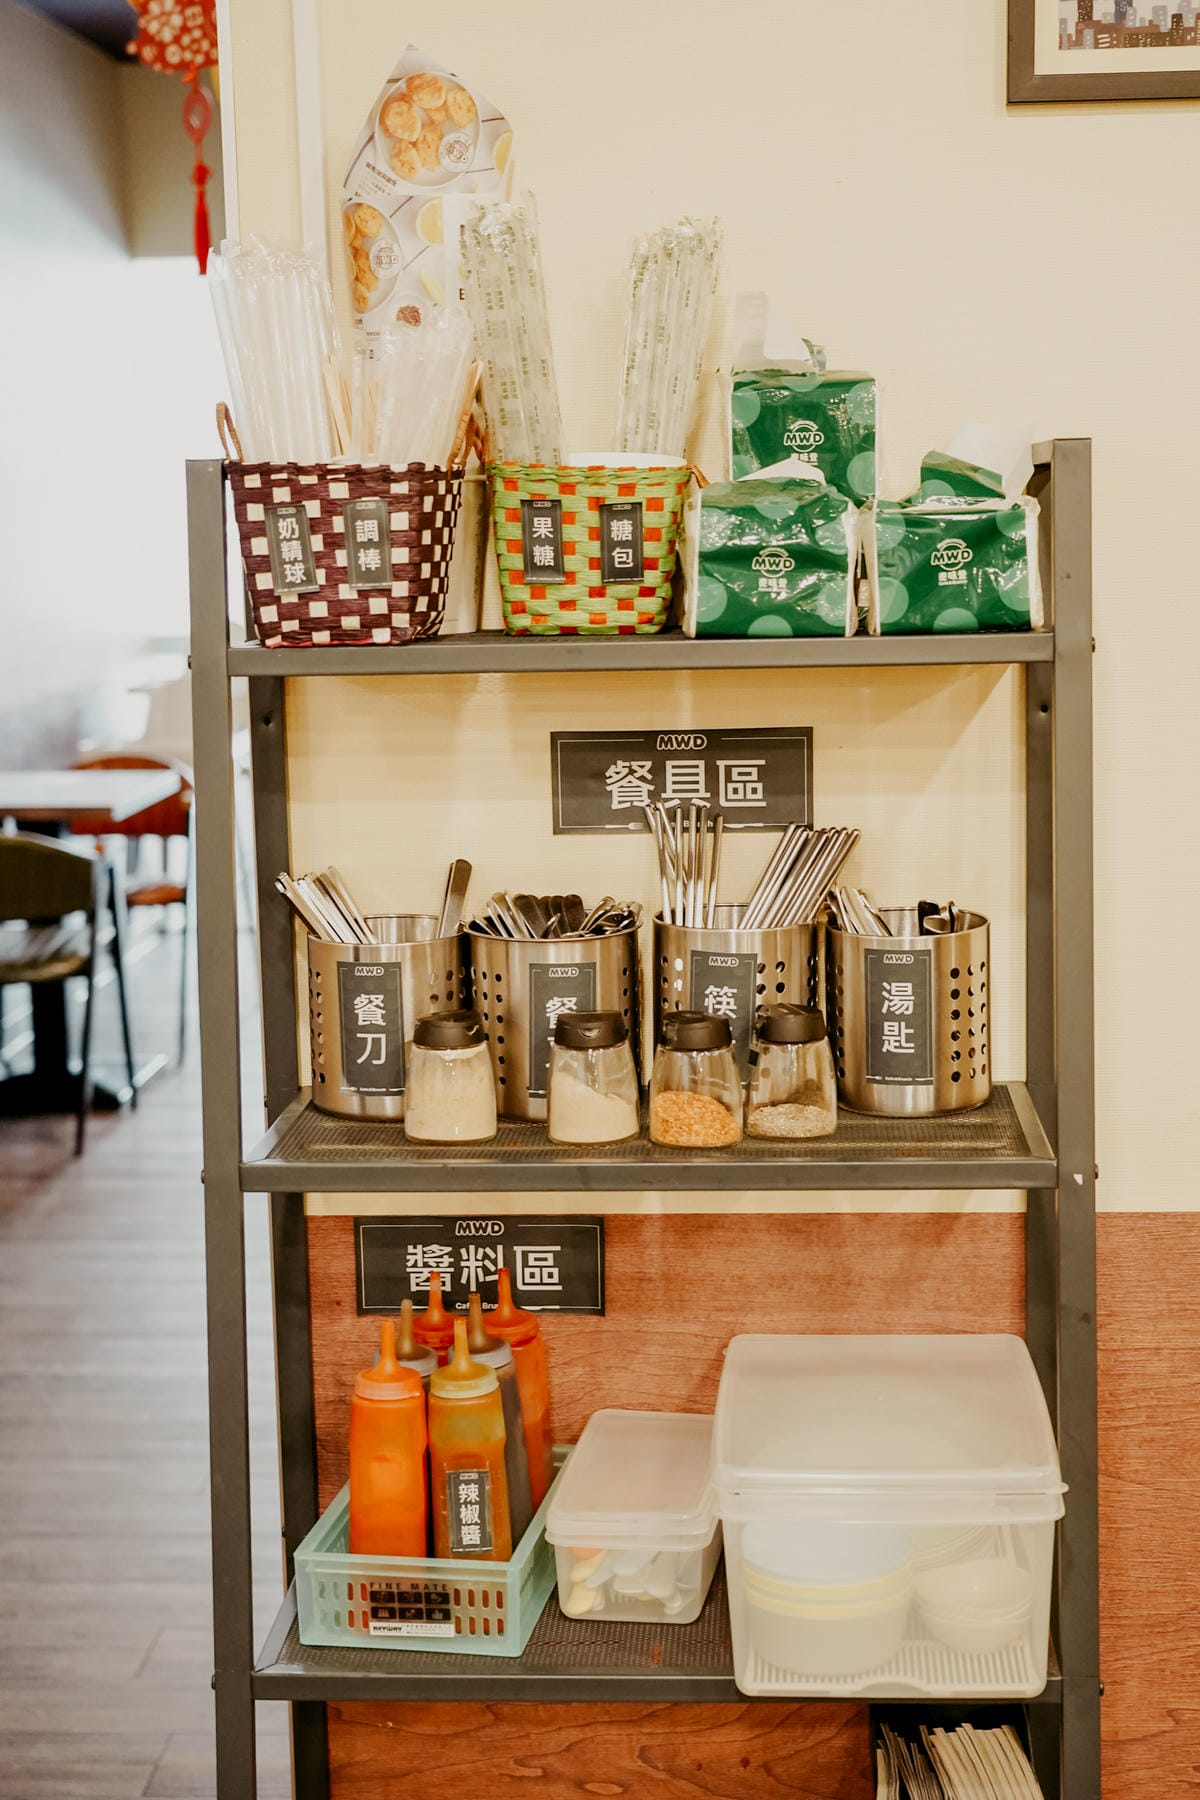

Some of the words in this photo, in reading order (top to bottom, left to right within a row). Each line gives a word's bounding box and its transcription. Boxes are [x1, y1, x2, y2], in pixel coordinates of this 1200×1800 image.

[783, 431, 824, 446] MWD
[277, 517, 307, 584] 奶精球
[354, 519, 382, 572] 調棒
[532, 517, 555, 567] 果糖
[610, 519, 634, 569] 糖包
[751, 556, 795, 571] MWD
[930, 548, 973, 566] MWD
[656, 734, 707, 750] MWD
[604, 759, 767, 810] 餐具區
[708, 956, 739, 967] MWD
[883, 953, 914, 965] MWD
[354, 966, 385, 977] MWD
[549, 967, 579, 977] MWD
[881, 981, 915, 1054] 湯匙
[353, 993, 387, 1065] 餐刀
[455, 1220, 504, 1236] MWD
[406, 1244, 563, 1292] 醬料區
[458, 1483, 481, 1545] 辣椒醬
[370, 1582, 401, 1591] FINE
[410, 1583, 448, 1591] MATE
